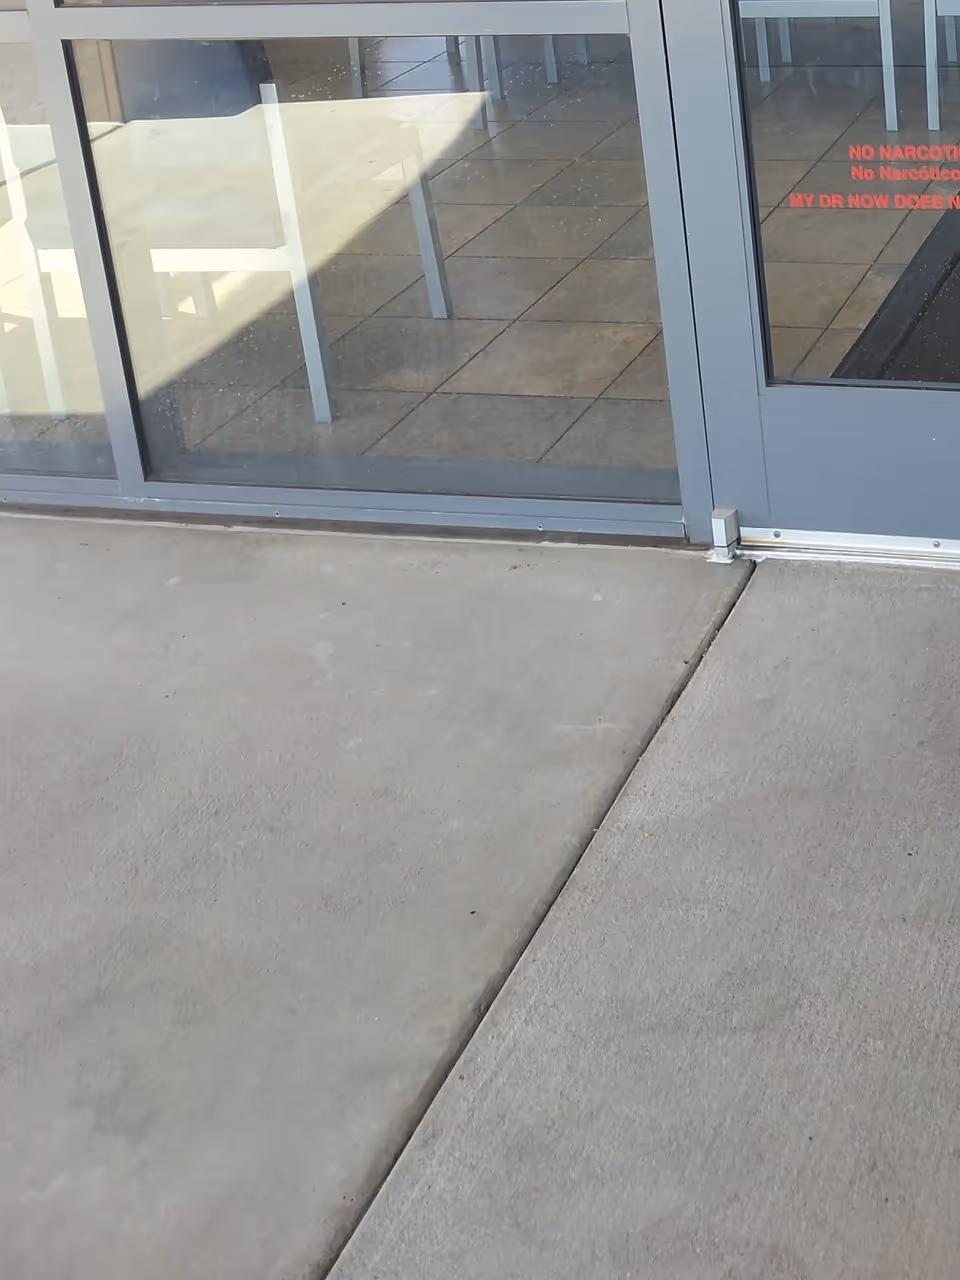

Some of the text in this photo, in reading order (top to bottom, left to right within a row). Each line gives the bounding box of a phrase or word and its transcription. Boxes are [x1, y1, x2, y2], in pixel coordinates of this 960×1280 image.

[848, 145, 875, 160] NO
[851, 165, 875, 181] No
[789, 194, 814, 208] MY
[819, 194, 844, 208] DR
[848, 194, 890, 209] NOW
[894, 194, 944, 210] DOES
